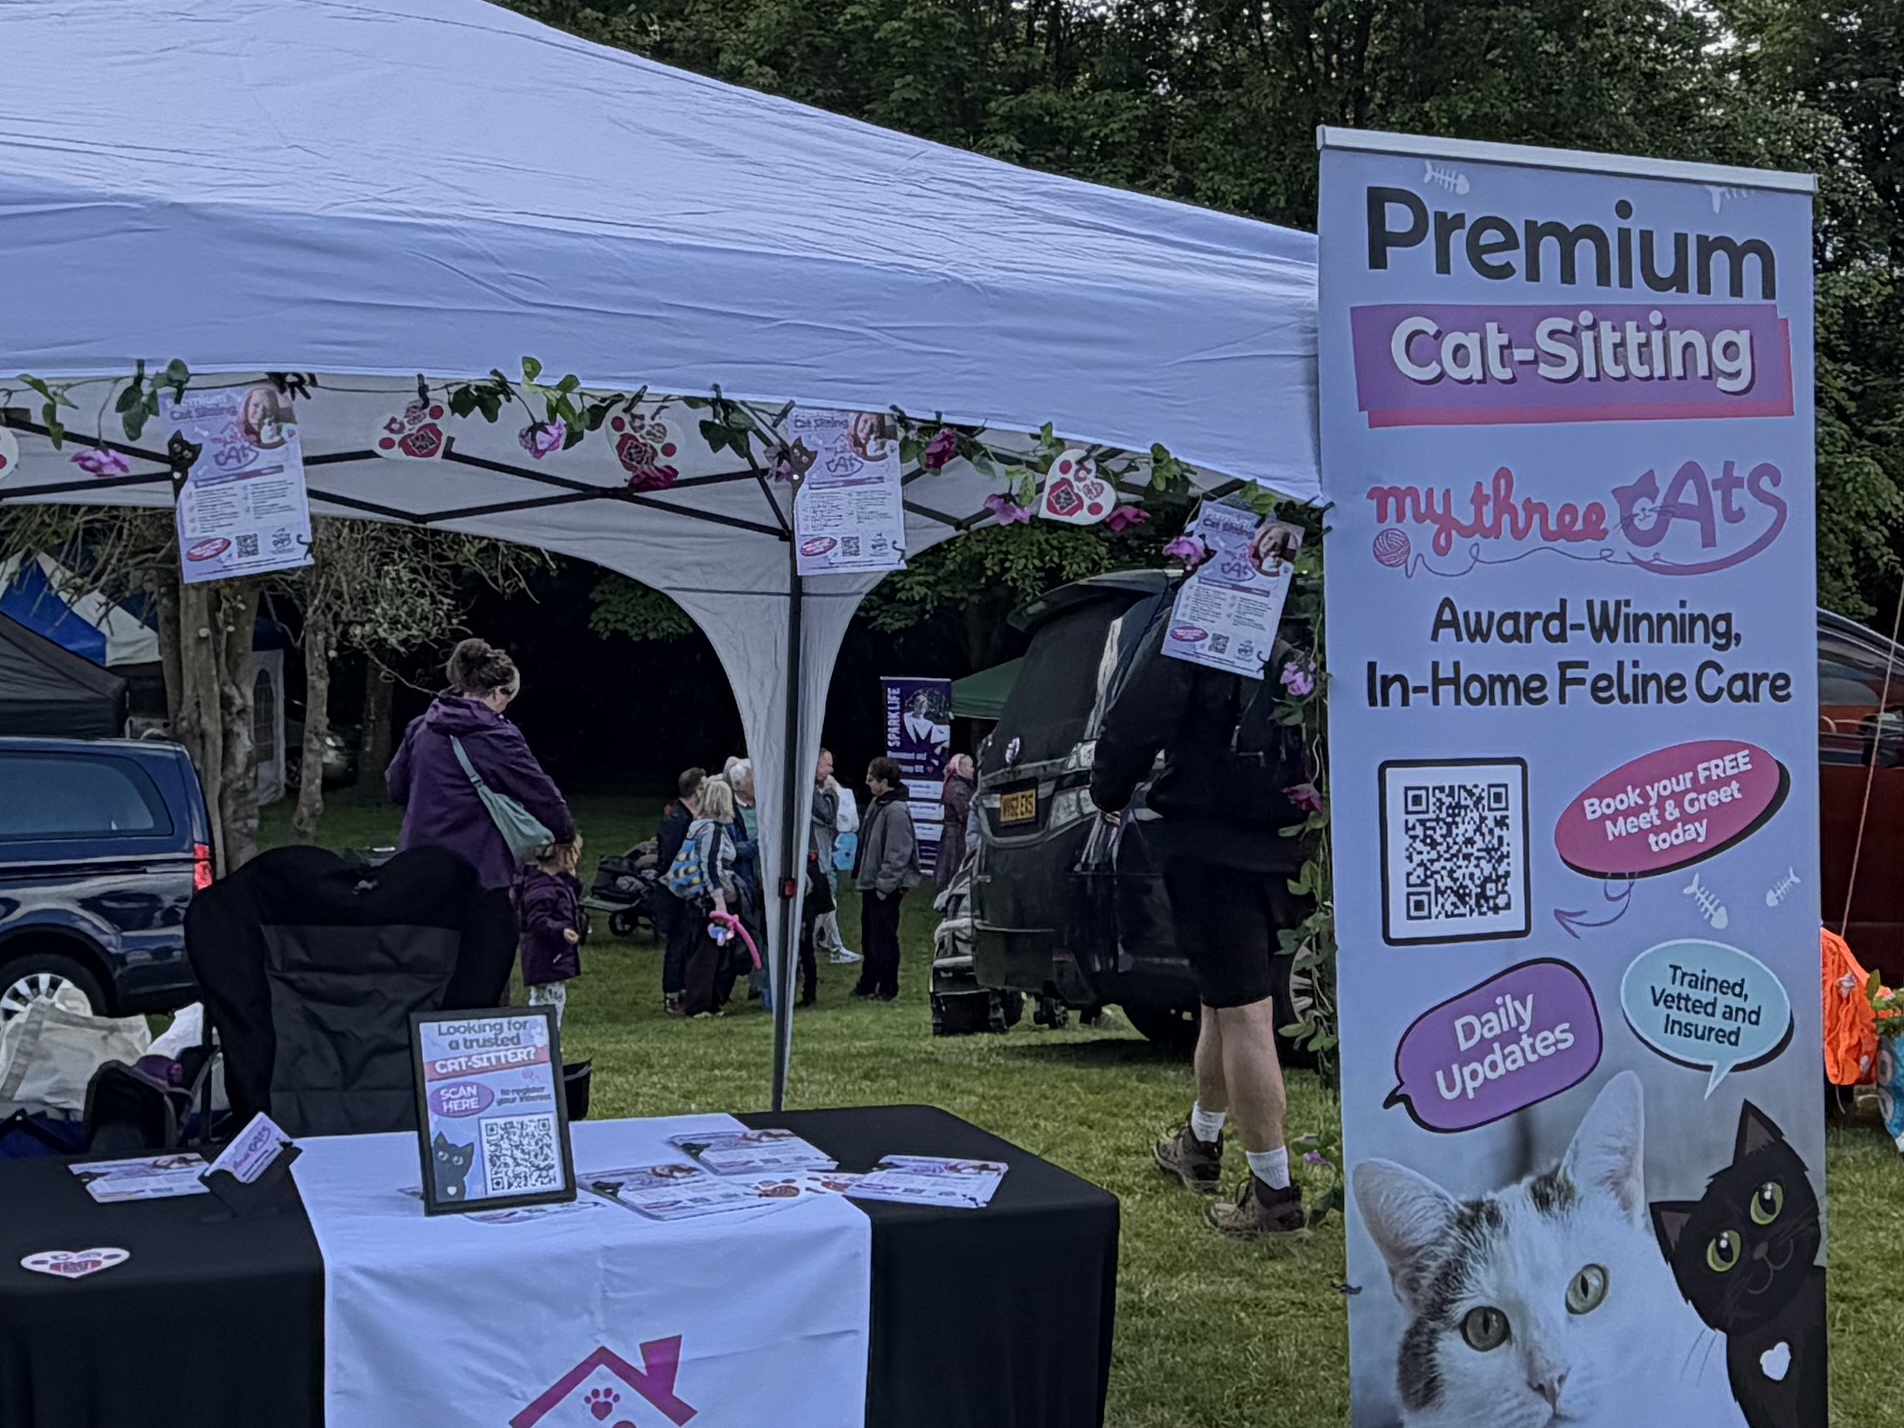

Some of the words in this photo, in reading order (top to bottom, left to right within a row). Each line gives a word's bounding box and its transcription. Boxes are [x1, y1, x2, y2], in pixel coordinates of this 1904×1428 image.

[1366, 186, 1776, 300] Premium
[1390, 309, 1755, 395] Cat-Sitting
[1431, 598, 1741, 651] Award-Winning,
[1367, 661, 1548, 708] In-Home
[1558, 661, 1687, 705] Feline
[1695, 661, 1791, 703] Care
[1584, 784, 1643, 822] Book
[1645, 769, 1694, 809] your
[1697, 749, 1753, 785] FREE
[1606, 807, 1662, 841] Meet
[1665, 798, 1680, 822] &
[1684, 781, 1743, 814] Greet
[1648, 818, 1709, 855] today
[1650, 985, 1717, 1019] Vetted
[1721, 998, 1762, 1027] and
[1668, 964, 1750, 1004] Trained,
[437, 1020, 504, 1037] Looking
[507, 1019, 529, 1032] for
[448, 1039, 460, 1051] a
[463, 1034, 521, 1050] trusted
[1454, 993, 1535, 1052] Daily
[1663, 1012, 1741, 1048] Insured
[1435, 1022, 1576, 1102] Updates
[440, 1085, 478, 1100] SCAN
[442, 1098, 480, 1112] HERE
